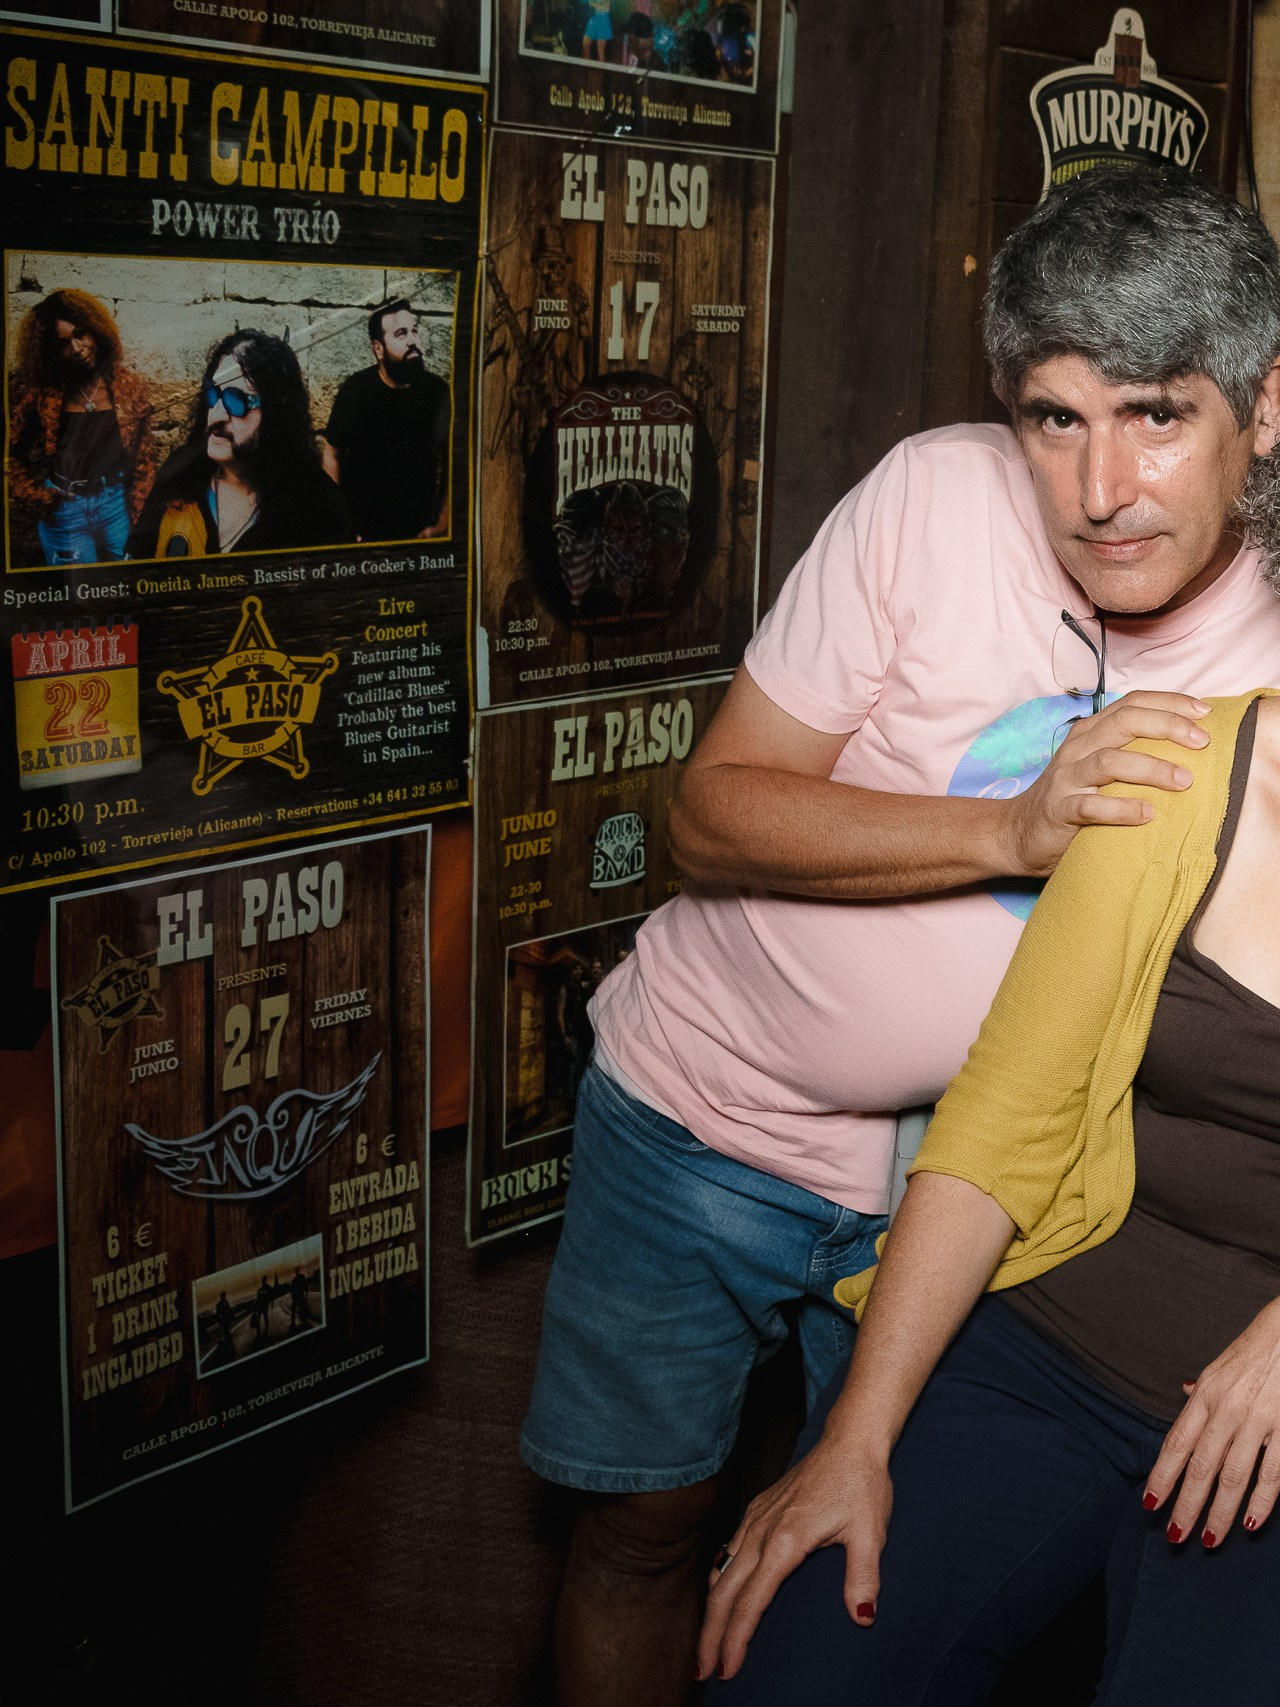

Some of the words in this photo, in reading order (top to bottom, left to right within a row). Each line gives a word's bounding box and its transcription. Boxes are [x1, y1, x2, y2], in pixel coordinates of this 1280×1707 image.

[173, 0, 217, 17] CALLE
[220, 7, 268, 24] APOLO
[272, 12, 300, 29] 102,
[300, 17, 375, 40] TORREVIEJA
[377, 29, 436, 48] ALICANTE
[550, 84, 573, 108] Calle
[578, 88, 605, 115] Apolo
[641, 97, 688, 126] Torrevieja
[692, 102, 732, 128] Alicante
[5, 56, 190, 182] SANTI
[210, 81, 468, 203] CAMPILLO
[1047, 88, 1195, 167] MURPHY'S
[560, 152, 605, 222] EL
[625, 158, 709, 229] PASO
[151, 198, 260, 241] POWER
[273, 200, 341, 245] TRÍO
[606, 250, 661, 265] PRESENTS
[534, 315, 571, 331] JUNIO
[537, 298, 568, 315] JUNE
[607, 280, 660, 360] 17
[691, 303, 747, 318] SATURDAY
[611, 406, 642, 421] THE
[4, 586, 70, 609] Special
[77, 583, 130, 600] Guest:
[136, 576, 191, 595] Oneida
[254, 566, 306, 585] Bassist
[312, 564, 327, 579] of
[332, 562, 356, 578] Joe
[361, 556, 415, 575] Cocker's
[420, 554, 455, 571] Band
[378, 597, 416, 616] Live
[365, 621, 428, 643] Concert
[508, 618, 539, 633] 22:30
[27, 635, 125, 675] APRIL
[235, 650, 266, 665] CAFÉ
[352, 646, 418, 665] Featuring
[421, 643, 442, 656] his
[495, 639, 525, 652] 10:30
[527, 636, 551, 649] p.m.
[358, 671, 384, 685] new
[389, 665, 435, 681] album:
[519, 668, 554, 683] CALLE
[556, 662, 591, 678] APOLO
[593, 659, 613, 672] 102,
[614, 651, 675, 669] TORREVIEJA
[675, 644, 721, 661] ALICANTE
[44, 676, 111, 742] 22
[196, 691, 232, 730] EL
[245, 684, 304, 720] PASO
[343, 687, 403, 707] "Cadillac
[408, 680, 450, 698] Blues"
[337, 707, 397, 728] Probably
[402, 703, 424, 719] the
[429, 700, 457, 715] best
[243, 743, 265, 755] BAR
[345, 730, 382, 747] Blues
[387, 720, 450, 740] Guitarist
[552, 715, 595, 782] EL
[603, 699, 694, 773] PASO
[21, 735, 136, 772] SATURDAY
[363, 749, 377, 763] in
[382, 743, 433, 763] Spain...
[595, 776, 648, 799] PRESENTS
[8, 855, 24, 870] C/
[31, 847, 76, 866] Apolo
[81, 840, 106, 858] 102
[121, 828, 193, 849] Torrevieja
[198, 812, 263, 837] (Alicante)
[277, 797, 359, 822] Reservations
[362, 792, 382, 805] +34
[386, 788, 408, 802] 641
[411, 784, 426, 798] 32
[429, 781, 442, 795] 55
[446, 778, 459, 791] 03
[22, 802, 84, 832] 10:30
[95, 798, 145, 825] p.m.
[501, 809, 557, 841] JUNIO
[504, 837, 552, 867] JUNE
[593, 846, 645, 881] BAND
[157, 889, 213, 967] EL
[241, 861, 344, 947] PASO
[499, 902, 527, 919] 10:30
[529, 898, 553, 915] p.m.
[88, 995, 109, 1018] EL
[113, 970, 150, 1002] PASO
[217, 963, 287, 991] PRESENTS
[310, 1004, 372, 1029] VIERNES
[314, 988, 367, 1012] FRIDAY
[134, 1040, 175, 1064] JUNE
[223, 993, 290, 1091] 27
[130, 1057, 178, 1083] JUNIO
[356, 1133, 367, 1164] 6
[380, 1133, 396, 1157] €
[329, 1160, 420, 1215] ENTRADA
[481, 1157, 558, 1211] ROCK
[107, 1226, 120, 1258] 6
[134, 1222, 152, 1247] €
[92, 1252, 168, 1308] TICKET
[329, 1242, 419, 1299] INCLUÍDA
[86, 1322, 97, 1354] 1
[112, 1290, 178, 1345] DRINK
[82, 1331, 183, 1401] INCLUDED
[122, 1434, 167, 1461] CALLE
[170, 1415, 218, 1442] APOLO
[222, 1404, 247, 1424] 102,
[247, 1371, 324, 1411] TORREVIEJA
[325, 1345, 385, 1380] ALICANTE
